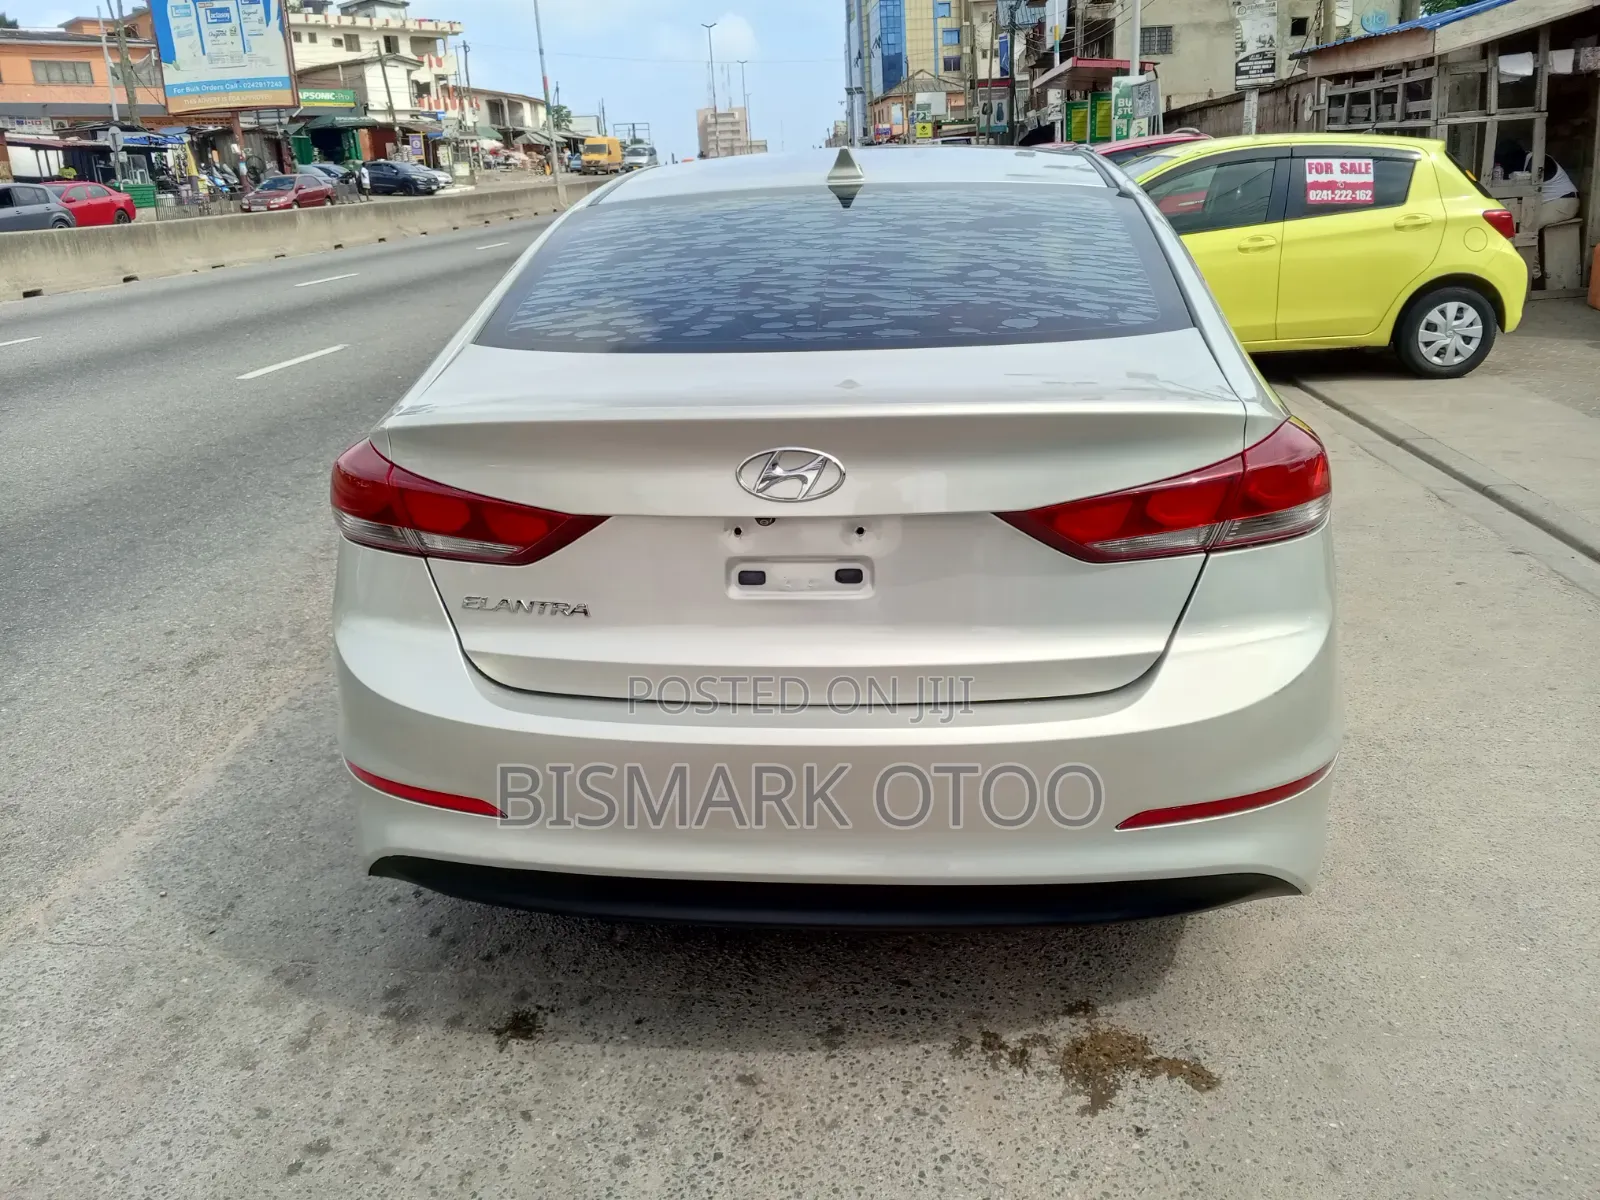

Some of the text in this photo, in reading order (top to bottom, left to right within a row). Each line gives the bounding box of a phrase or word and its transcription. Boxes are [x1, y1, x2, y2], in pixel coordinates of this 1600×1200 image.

[1118, 98, 1133, 107] BU
[1117, 107, 1133, 115] STO
[1308, 162, 1372, 175] FOR SALE
[1309, 189, 1373, 201] 0241-222-162
[461, 596, 592, 618] ELANTRA
